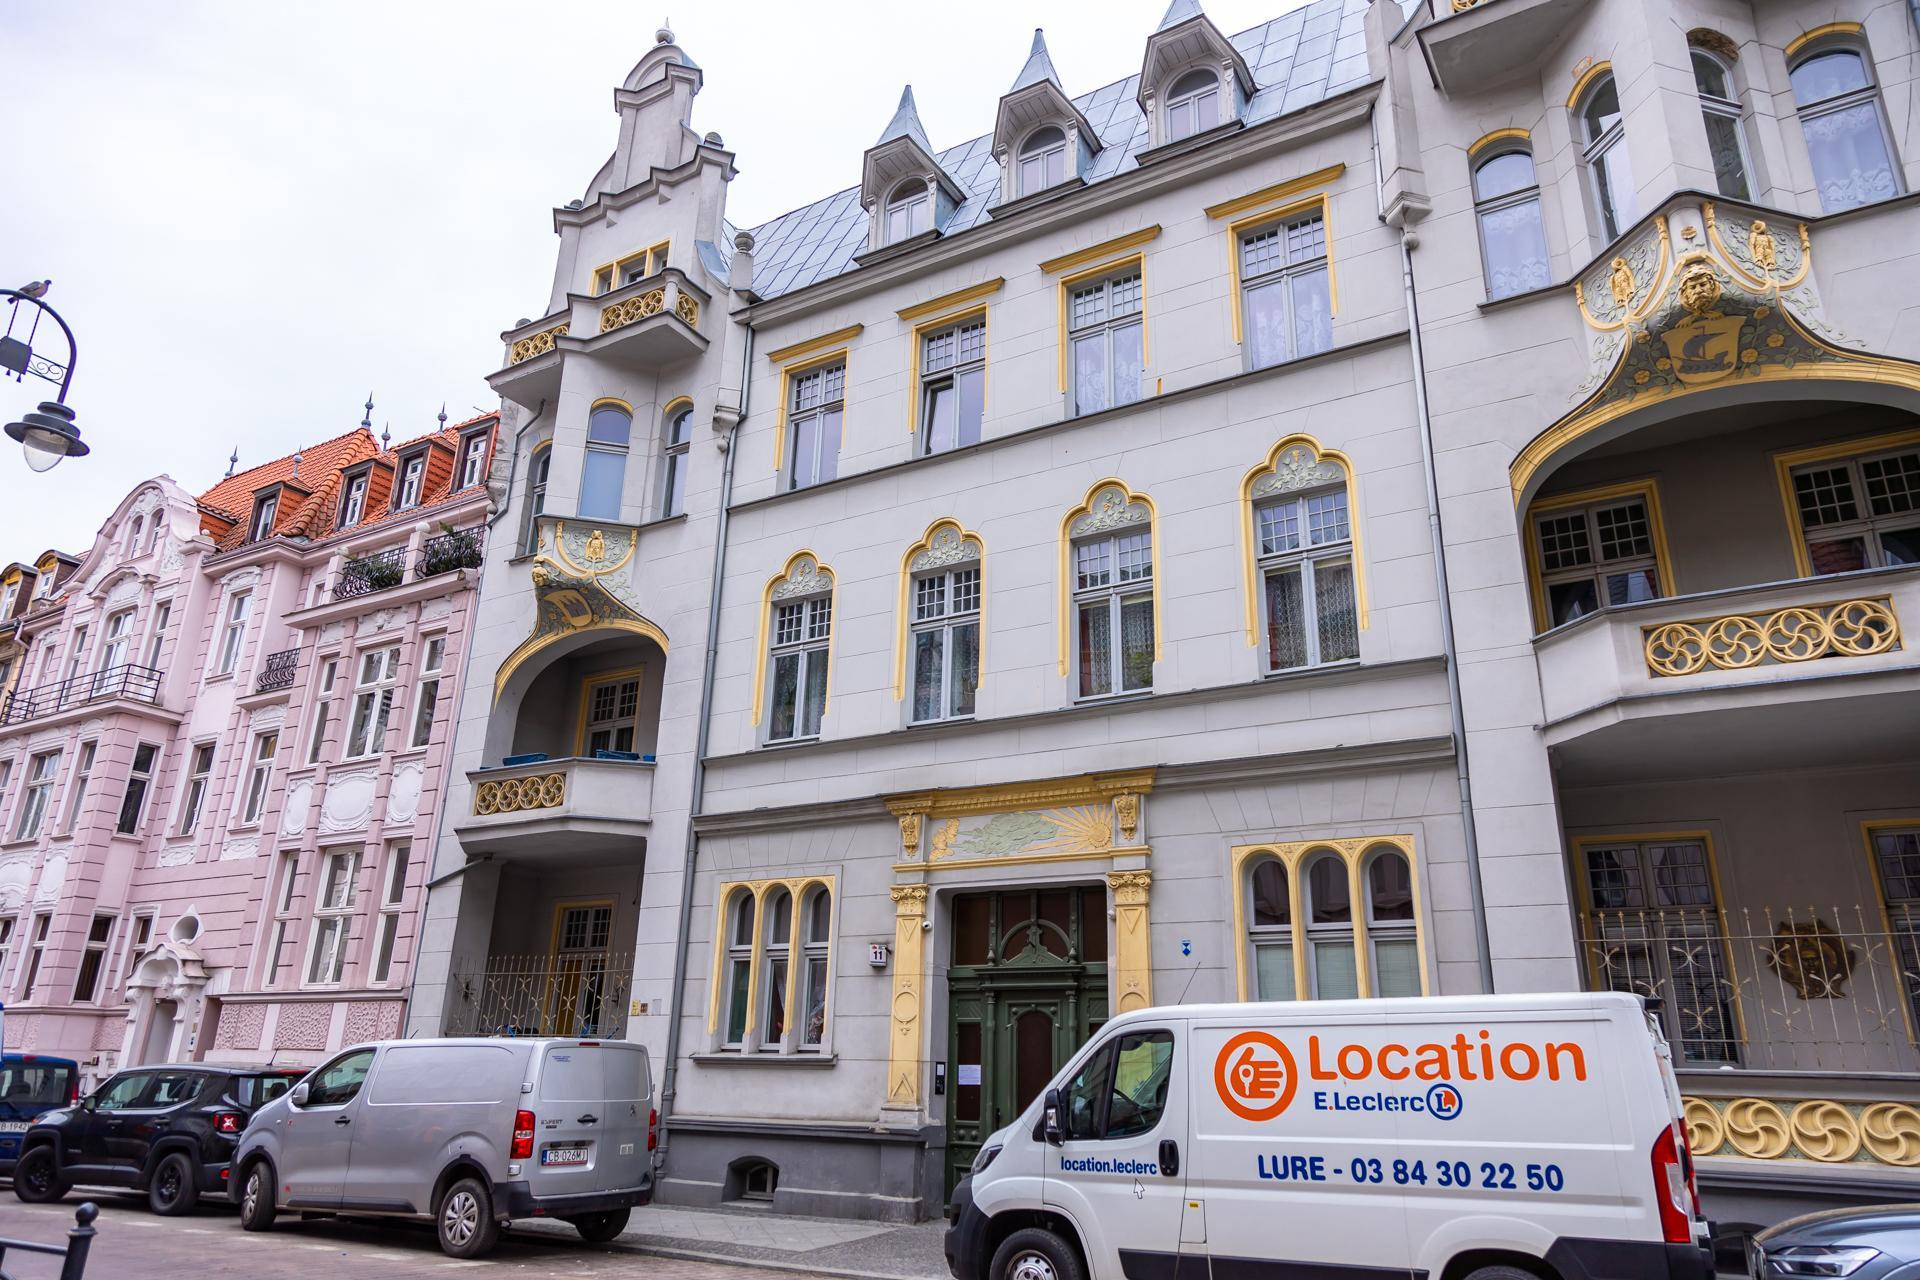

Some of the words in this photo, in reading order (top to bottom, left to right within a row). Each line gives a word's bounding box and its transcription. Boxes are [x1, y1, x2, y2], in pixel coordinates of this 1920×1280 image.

[873, 950, 882, 960] 11
[1308, 1029, 1588, 1082] Location
[1313, 1091, 1425, 1113] E.Leclerc
[548, 1151, 559, 1161] CB
[1060, 1156, 1158, 1176] location.leclerc
[1257, 1154, 1327, 1182] LURE
[1350, 1157, 1384, 1184] 03
[1392, 1158, 1428, 1185] 84
[1435, 1160, 1472, 1188] 30
[1479, 1161, 1517, 1190] 22
[1526, 1163, 1565, 1192] 50
